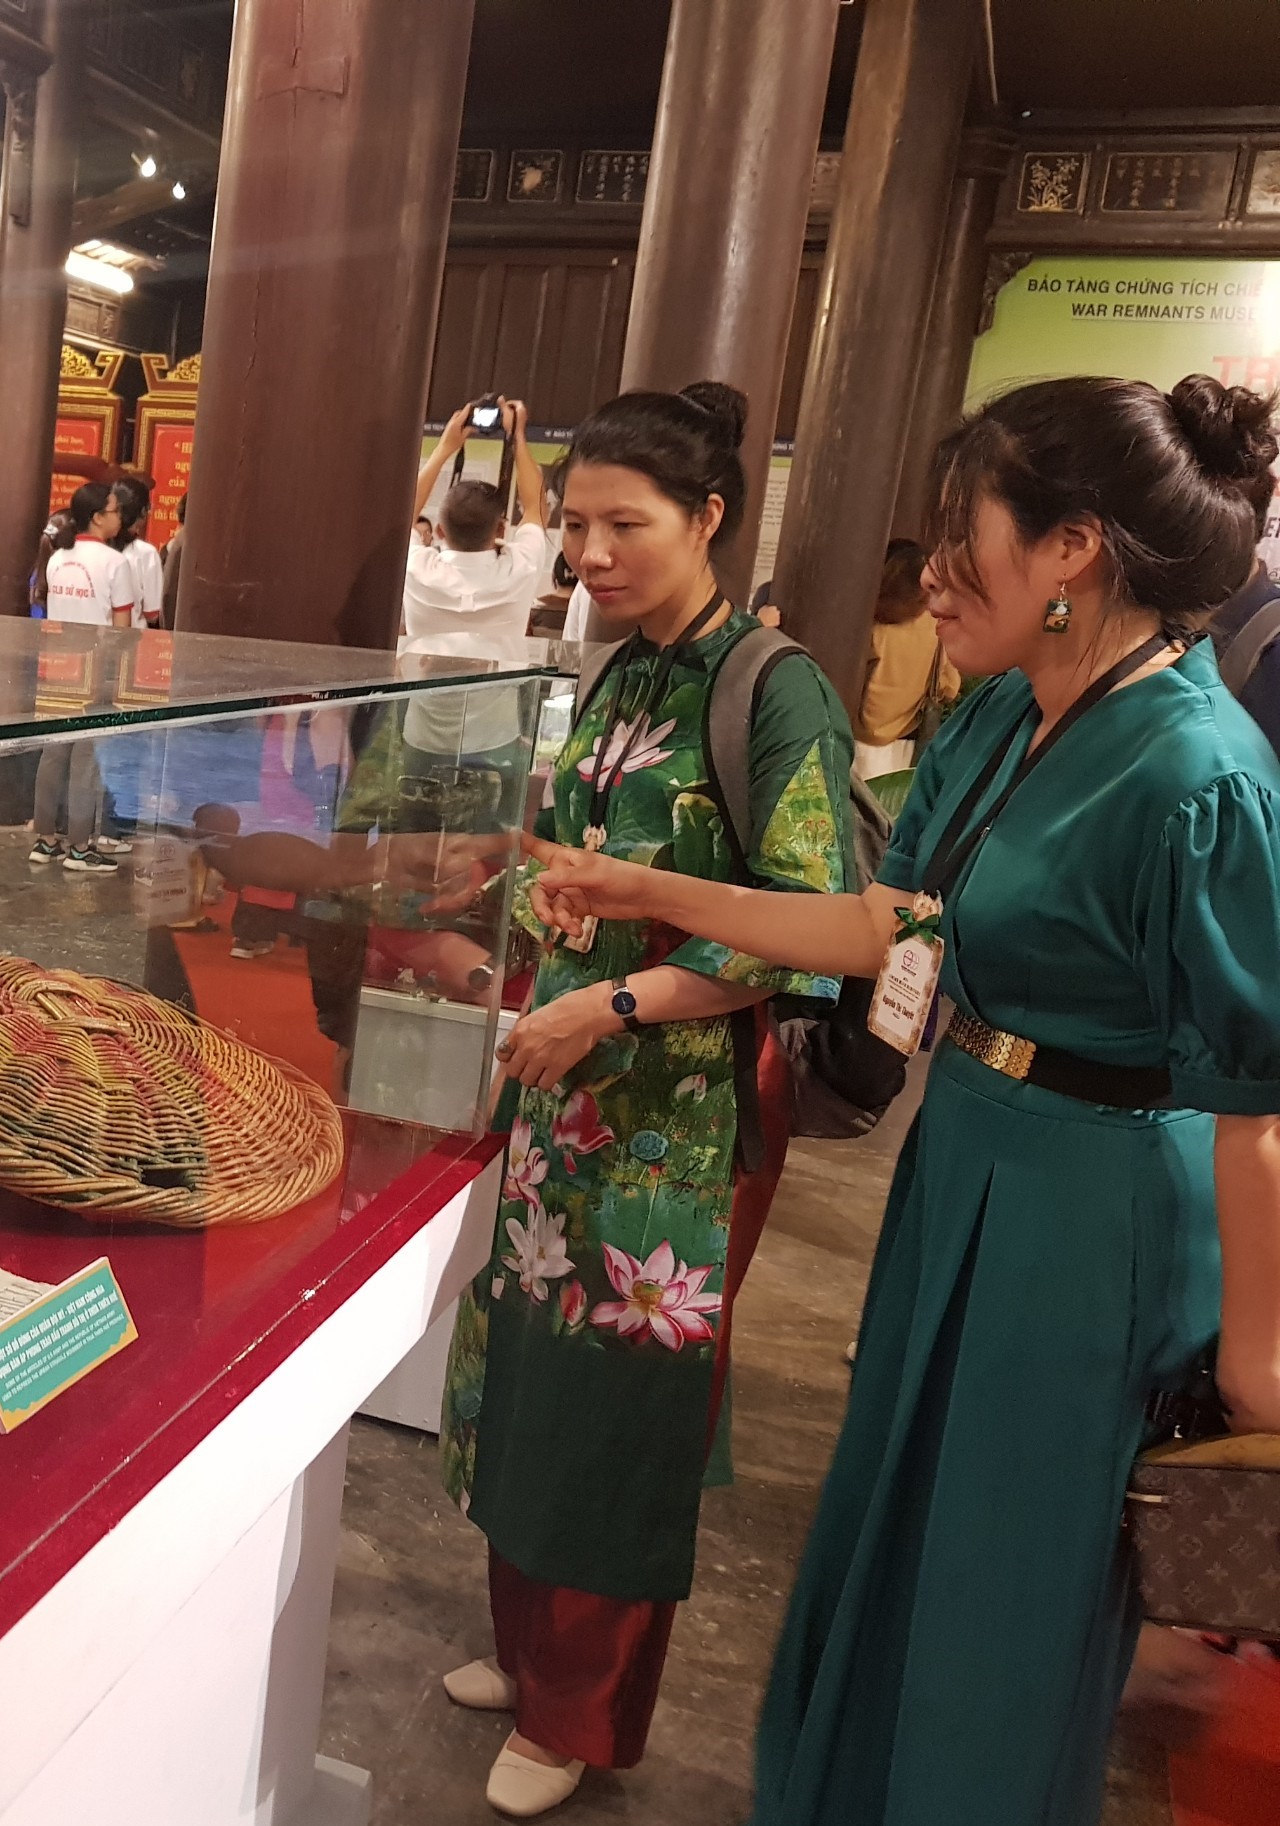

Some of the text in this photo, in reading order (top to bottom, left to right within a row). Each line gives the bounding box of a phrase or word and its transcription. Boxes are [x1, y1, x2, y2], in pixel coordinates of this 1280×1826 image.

[1027, 273, 1062, 293] BẢO
[1066, 276, 1110, 294] TÀNG
[1115, 278, 1175, 295] CHỨNG
[1179, 278, 1219, 296] TÍCH
[1071, 302, 1257, 321] WAR REMNANTS MUSE
